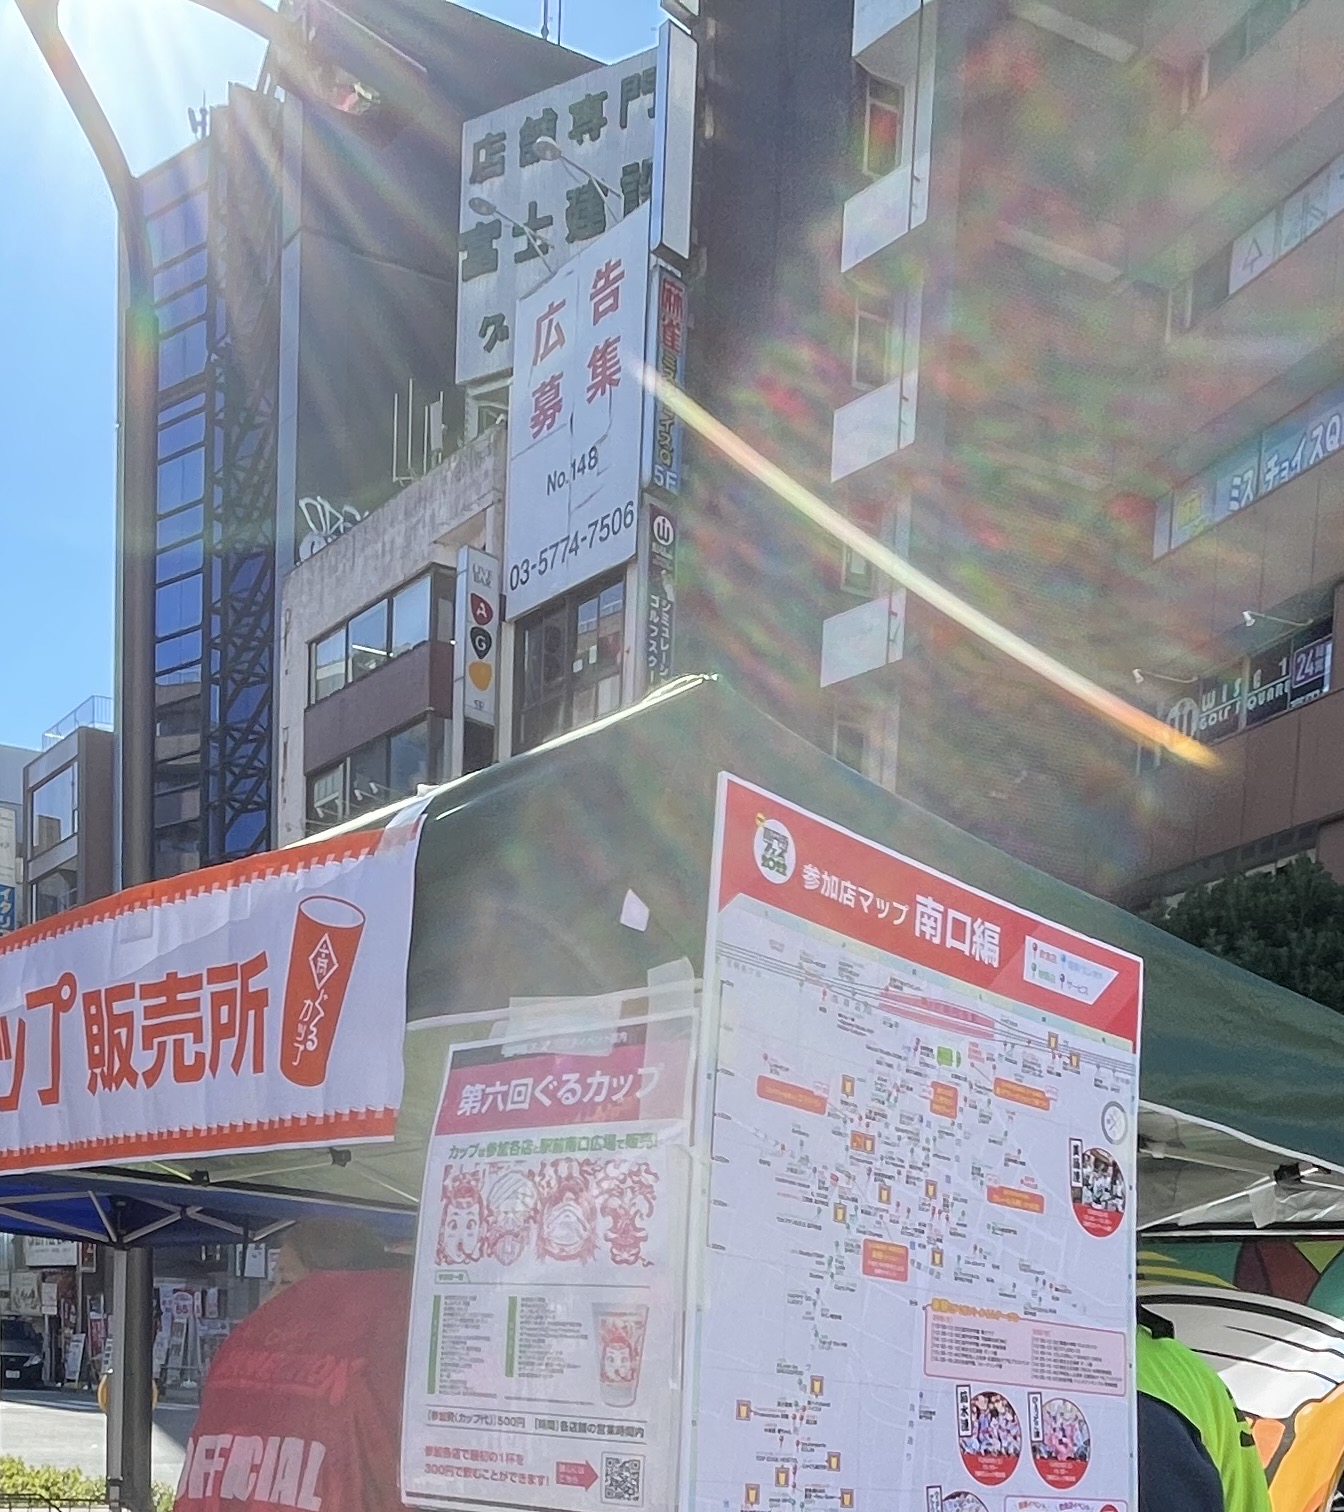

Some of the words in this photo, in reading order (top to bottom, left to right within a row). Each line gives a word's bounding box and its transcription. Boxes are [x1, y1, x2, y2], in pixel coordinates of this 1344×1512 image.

[532, 258, 626, 368] 広告
[529, 334, 623, 440] 募集
[509, 499, 636, 592] 03-5774-7506
[801, 863, 910, 926] 参加店マップ
[913, 893, 1002, 968] 南口編
[456, 1061, 665, 1117] 第六回ぐるカップ
